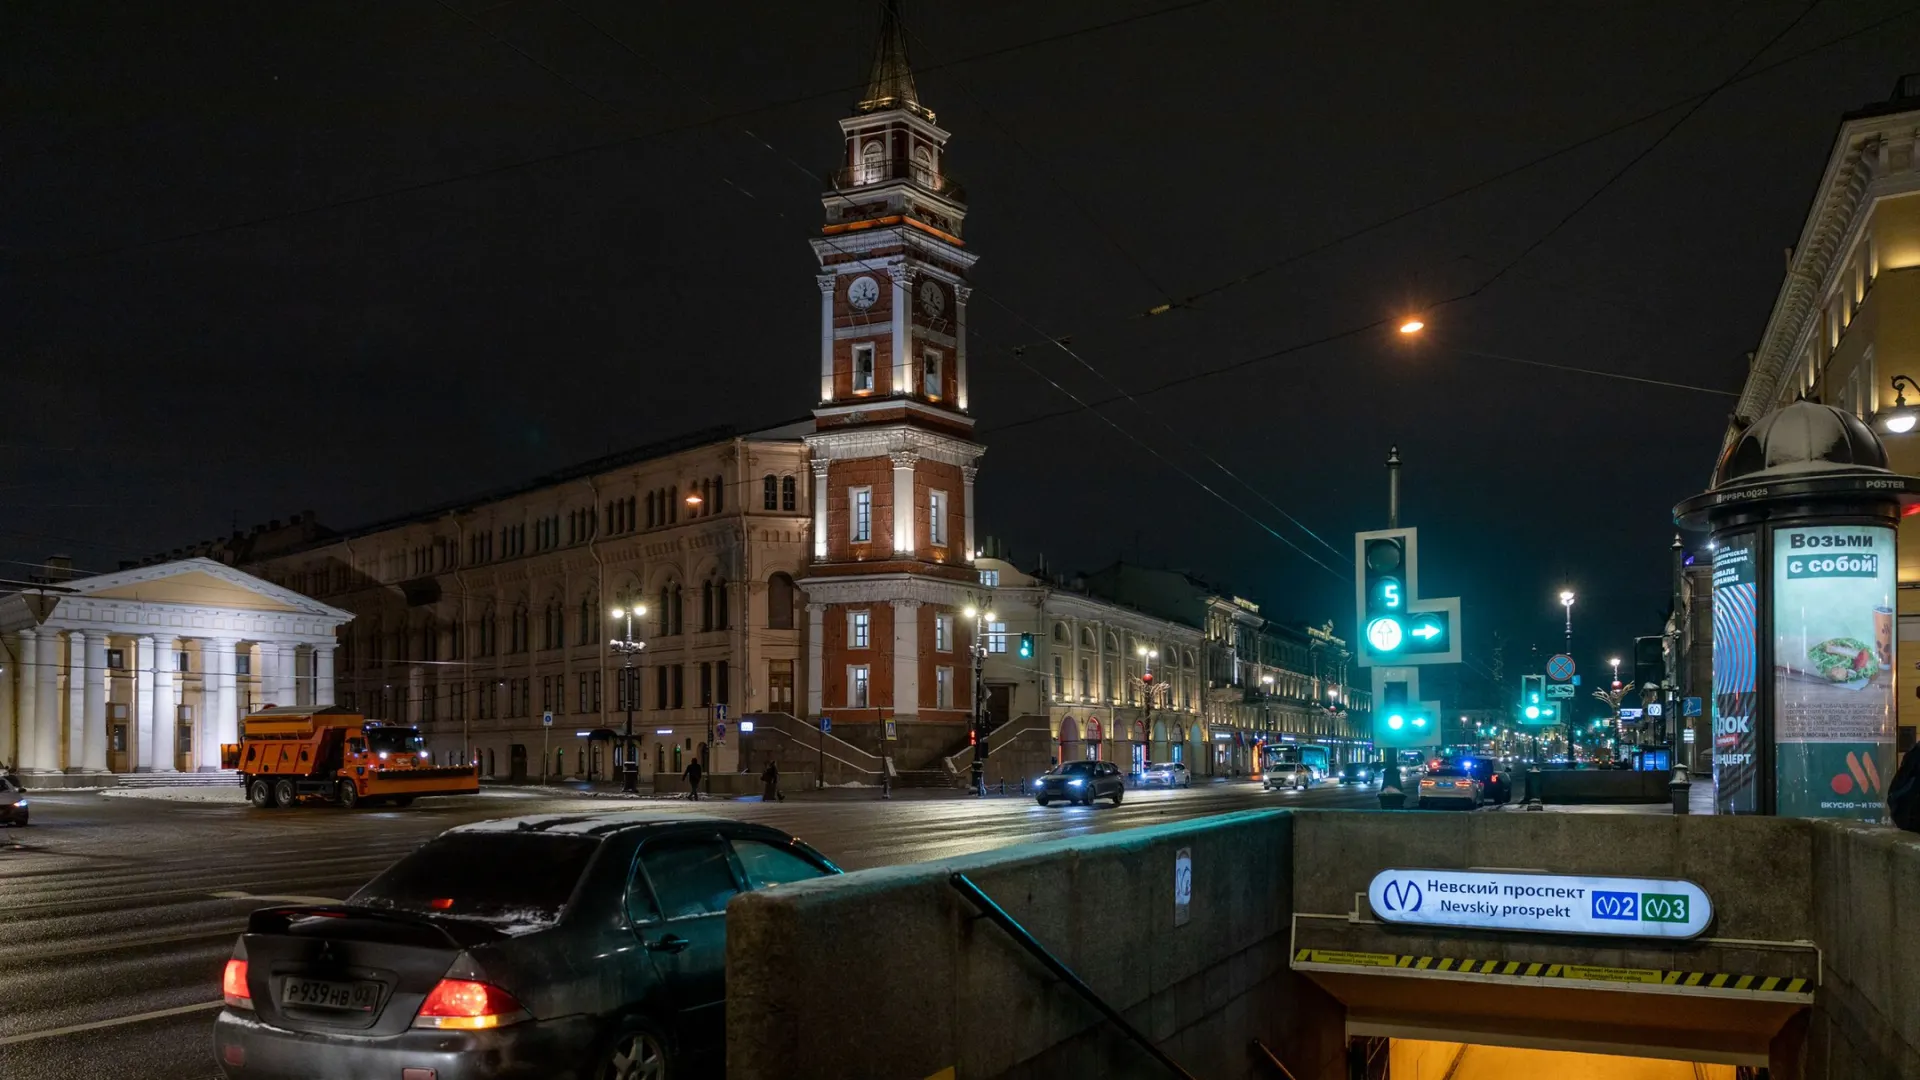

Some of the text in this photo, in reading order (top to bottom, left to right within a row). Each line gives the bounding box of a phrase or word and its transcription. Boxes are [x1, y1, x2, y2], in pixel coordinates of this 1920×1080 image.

[1866, 480, 1904, 489] POSTER
[1790, 533, 1873, 549] Возьми
[1789, 554, 1877, 574] с собой!
[1384, 584, 1400, 608] 5
[1821, 801, 1855, 809] ВКУСНО
[1427, 879, 1586, 900] Невский проспект
[1440, 900, 1571, 920] Nevskiy prospekt
